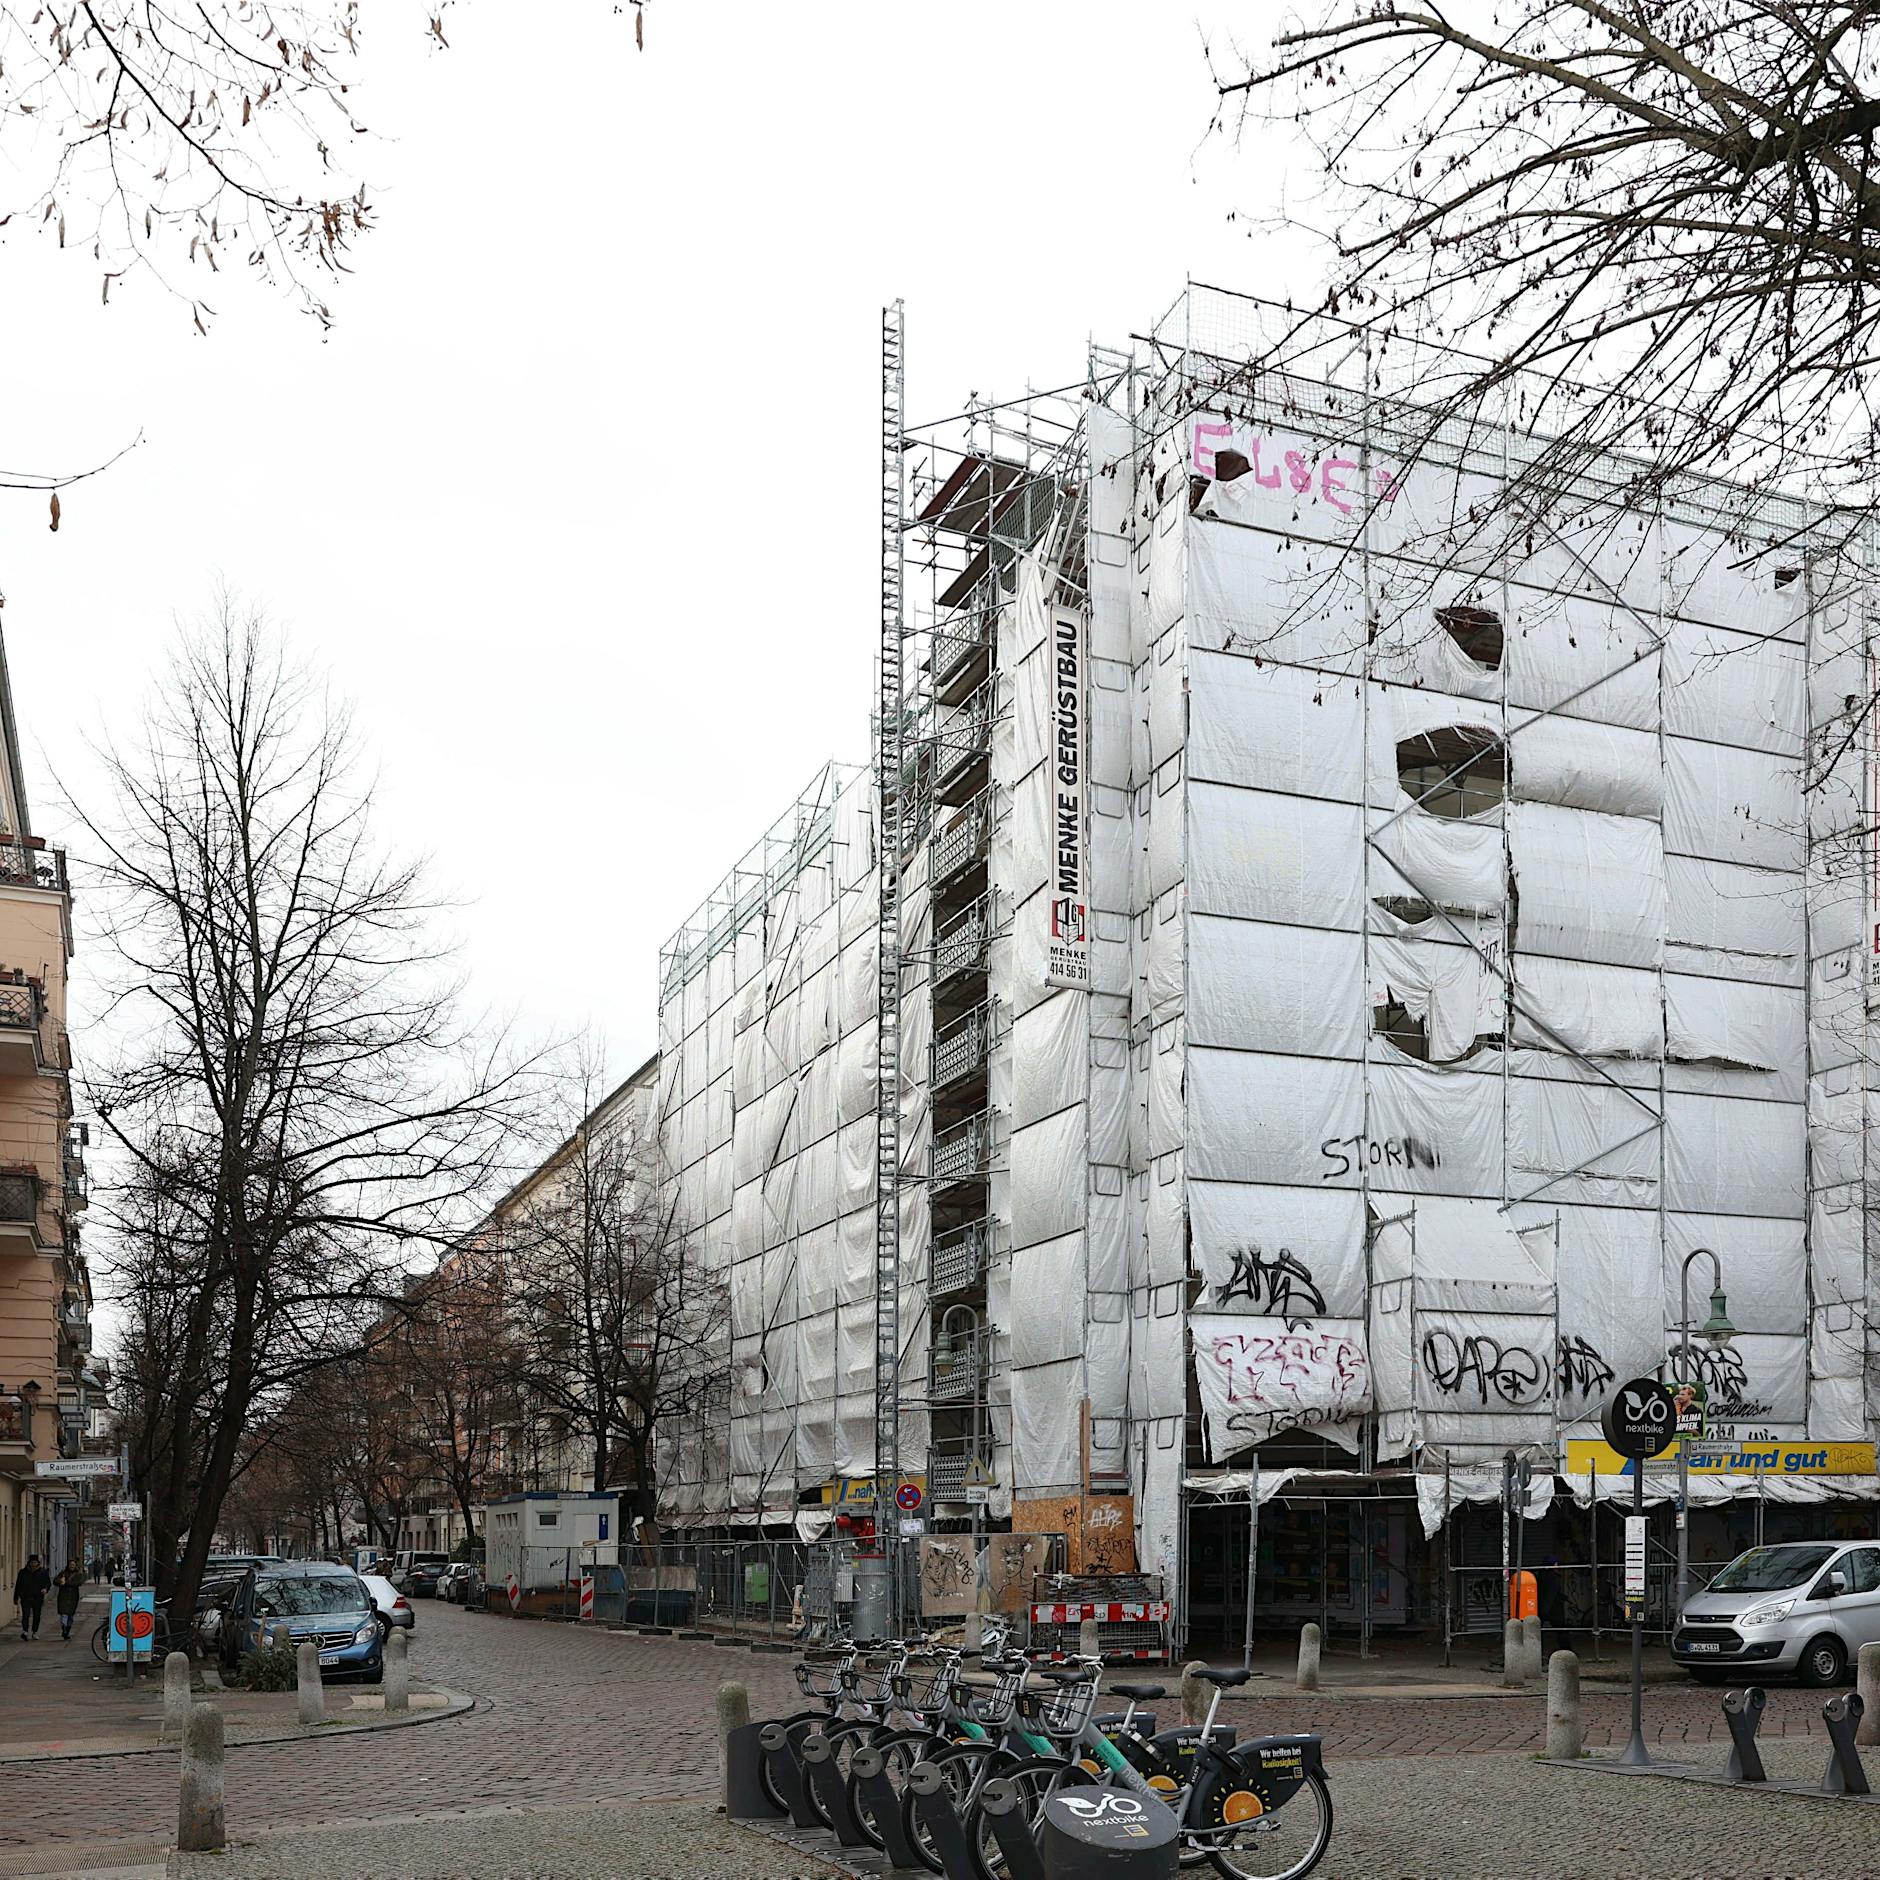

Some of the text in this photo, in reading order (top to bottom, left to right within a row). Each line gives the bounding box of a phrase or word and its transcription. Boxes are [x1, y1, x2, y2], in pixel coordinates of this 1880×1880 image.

[1052, 620, 1078, 894] MENKE GERÜSTBAU
[1050, 947, 1086, 960] MENKE
[1050, 962, 1087, 980] 414 56 31
[1625, 1423, 1664, 1434] nextbike
[1729, 1449, 1780, 1468] und
[1785, 1449, 1828, 1472] gut
[1177, 1737, 1187, 1746] Wir
[1260, 1746, 1302, 1758] Wir helfen bei
[1082, 1814, 1149, 1828] nextbike
